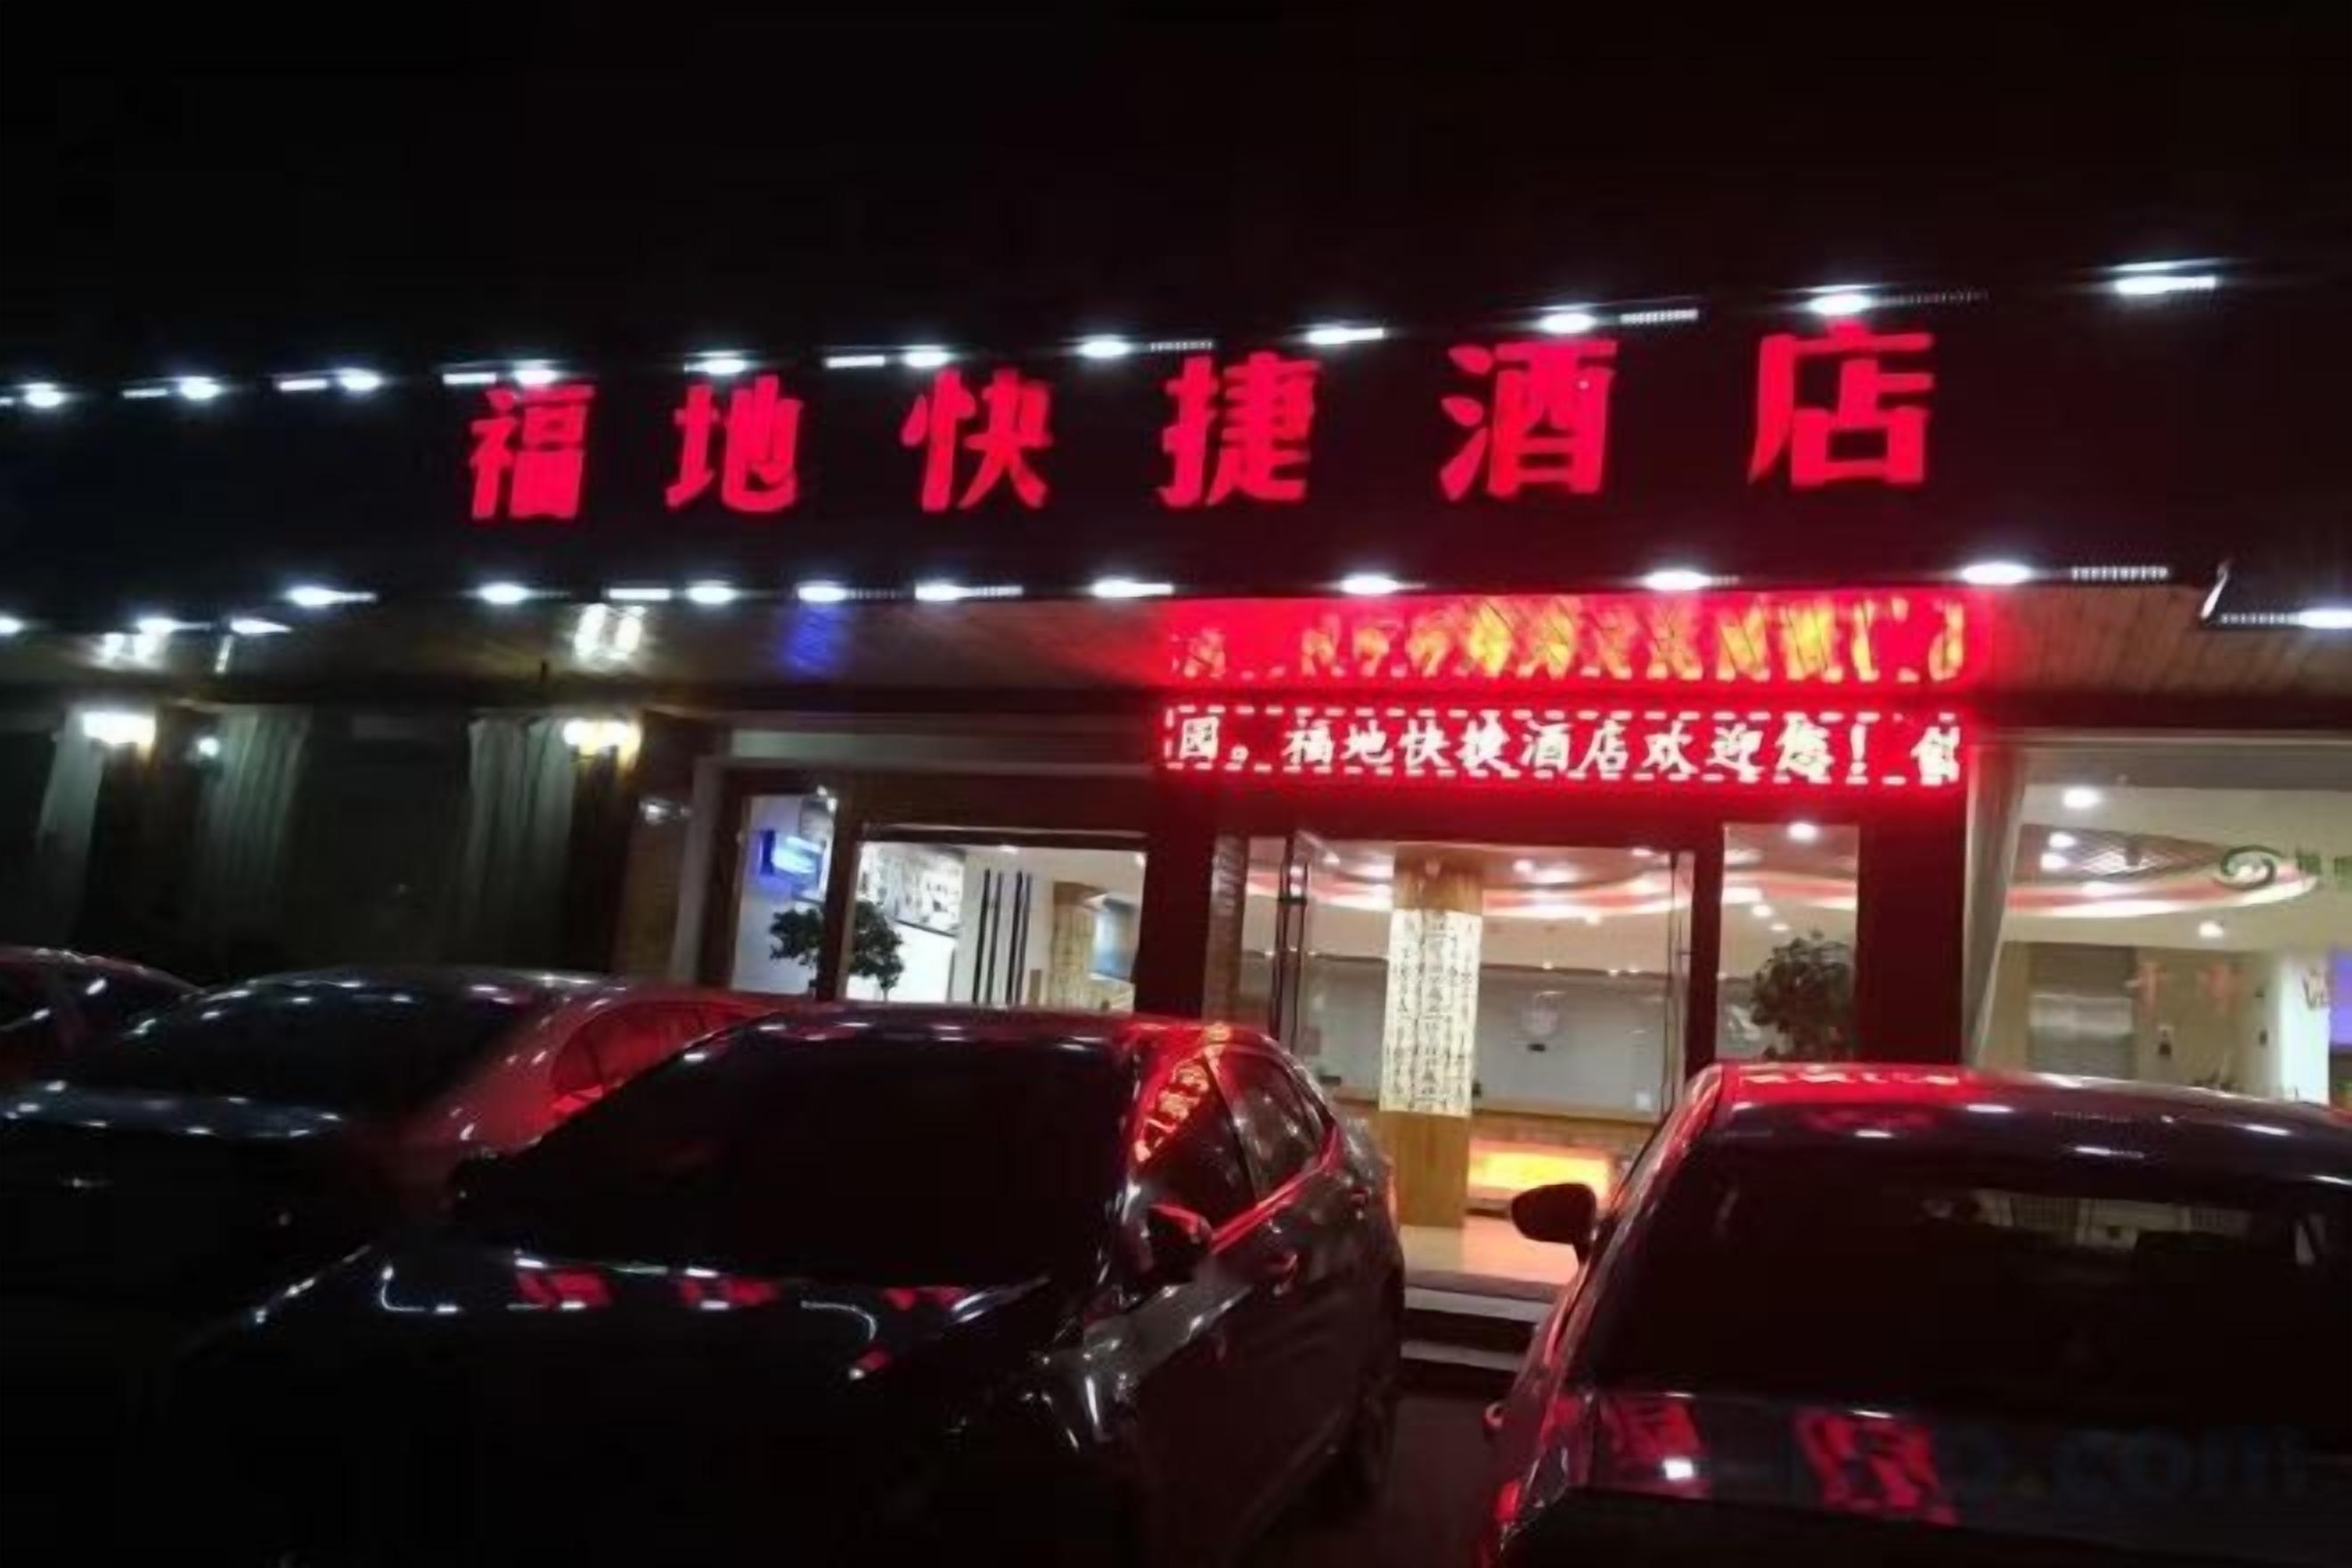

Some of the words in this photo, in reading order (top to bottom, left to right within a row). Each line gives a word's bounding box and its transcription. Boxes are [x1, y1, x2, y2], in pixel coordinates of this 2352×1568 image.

[471, 319, 1934, 520] 福地快捷酒店
